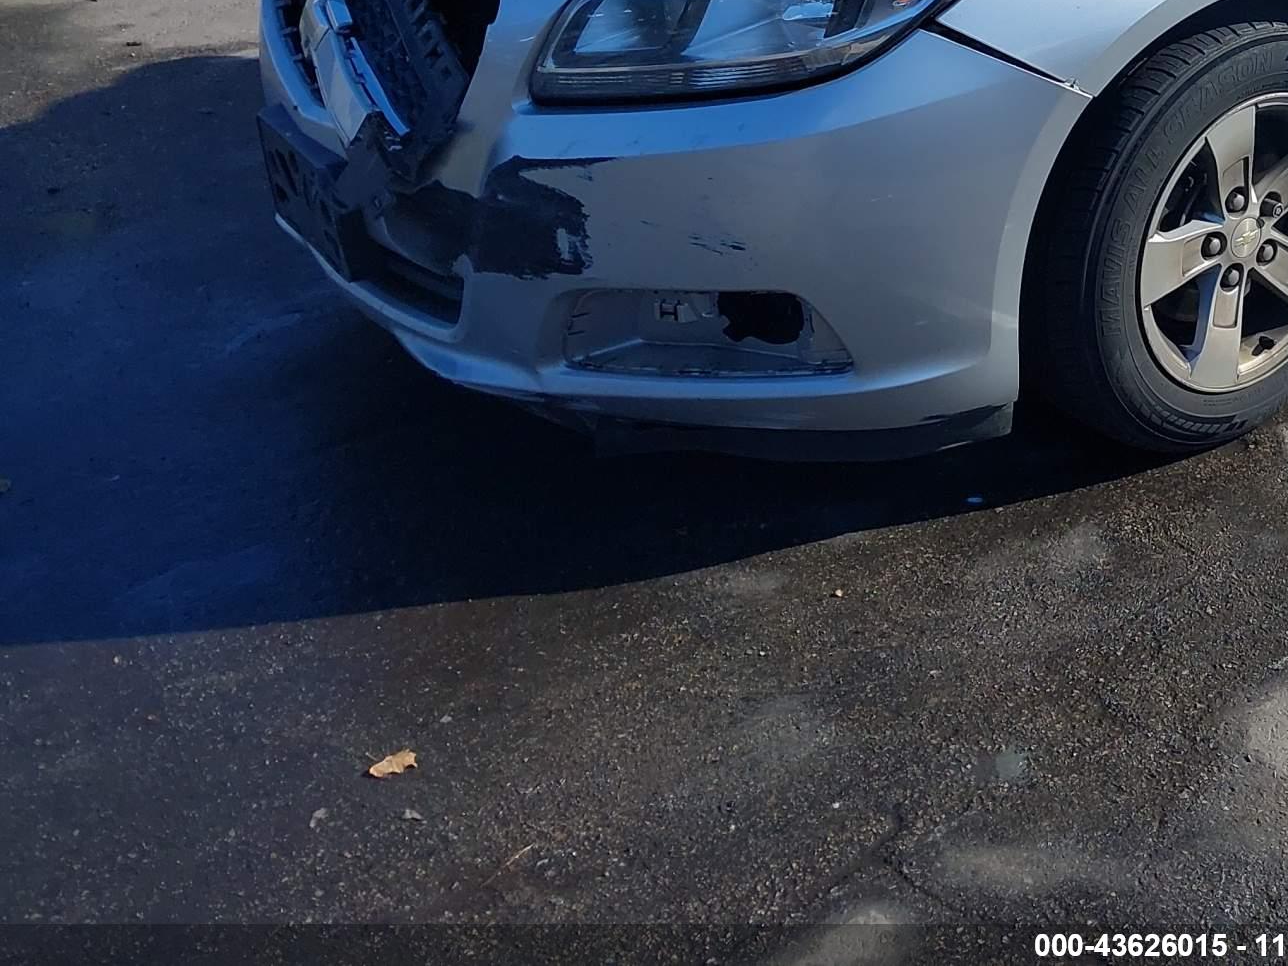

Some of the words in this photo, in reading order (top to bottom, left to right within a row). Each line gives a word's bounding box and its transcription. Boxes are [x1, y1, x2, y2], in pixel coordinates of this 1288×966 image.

[1101, 217, 1132, 339] MAVIS
[1123, 143, 1166, 218] ALL
[1161, 49, 1275, 146] SEASON
